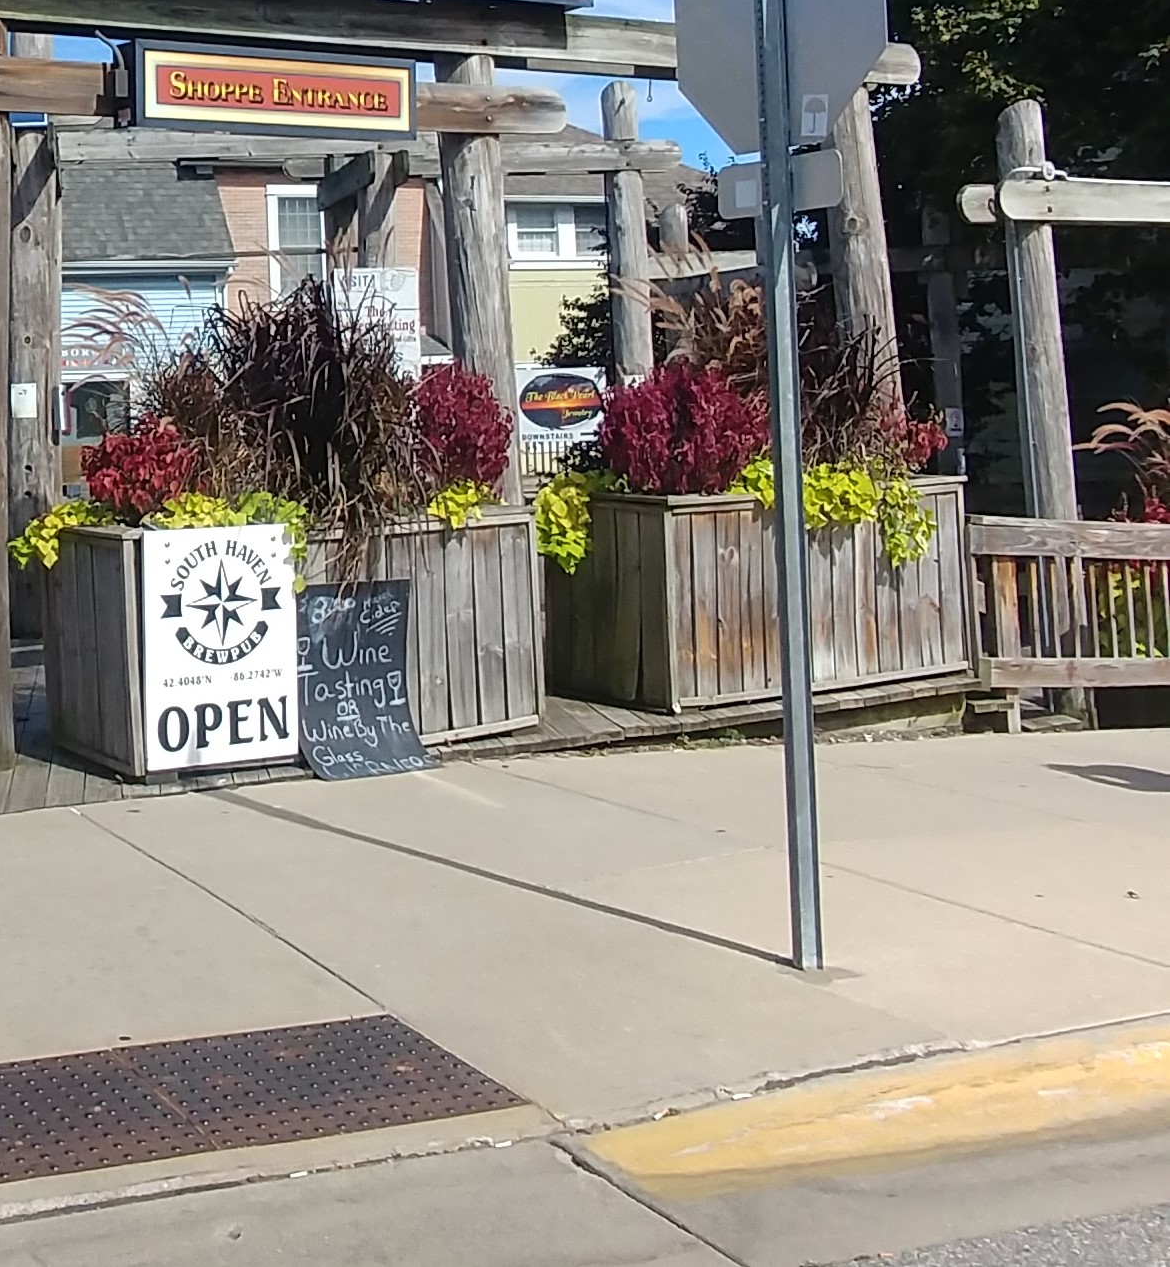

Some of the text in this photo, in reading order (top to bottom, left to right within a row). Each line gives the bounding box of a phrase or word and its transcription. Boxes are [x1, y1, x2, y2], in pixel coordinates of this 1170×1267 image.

[521, 432, 574, 441] DOWNSTAIRS
[170, 539, 272, 591] SOUTH HAVEN
[359, 599, 401, 624] Cider
[182, 630, 262, 664] BREWPUB
[322, 630, 393, 670] Wine
[297, 670, 386, 708] Tasting
[157, 694, 290, 753] OPEN
[336, 700, 359, 717] OR
[302, 714, 411, 748] Wine By The
